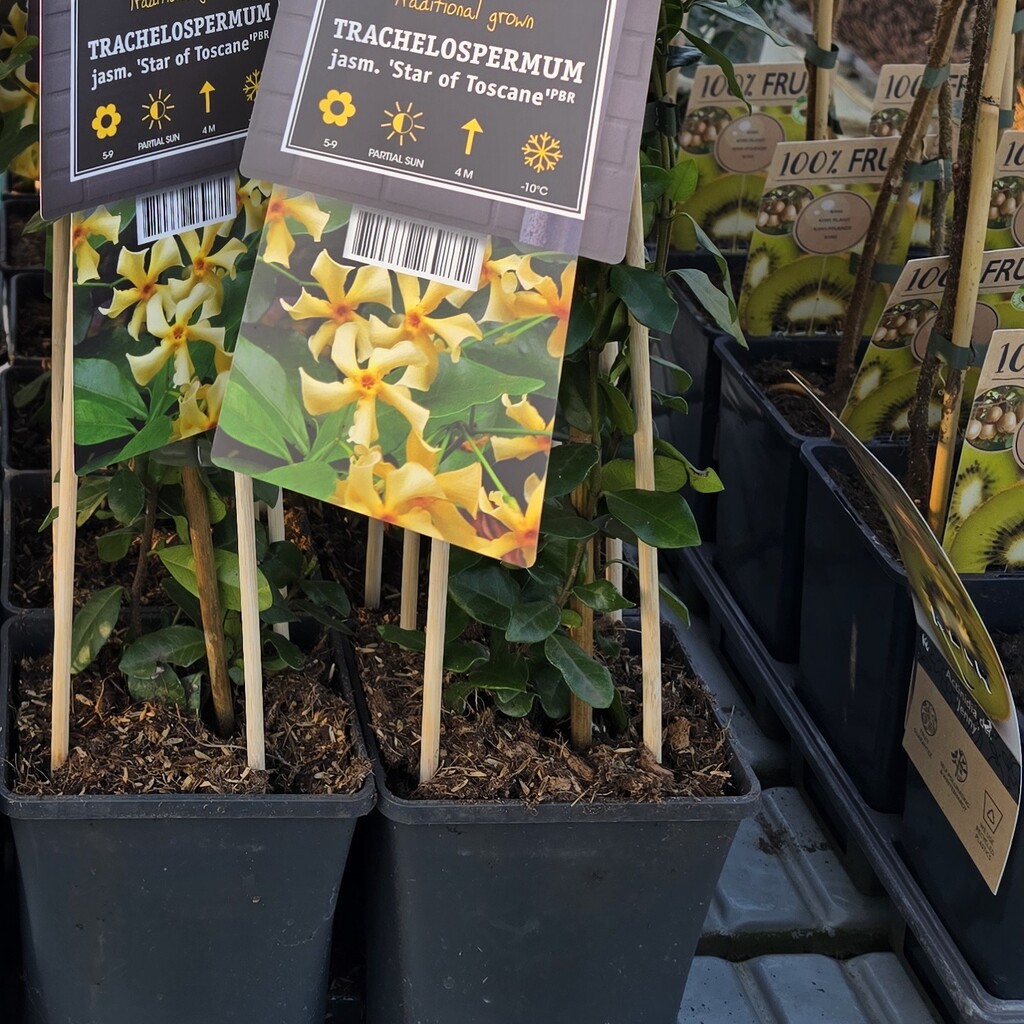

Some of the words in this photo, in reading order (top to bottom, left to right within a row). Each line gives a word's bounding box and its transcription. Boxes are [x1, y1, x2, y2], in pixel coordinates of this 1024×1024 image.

[88, 2, 272, 61] TRACHELOSPERMUM
[486, 9, 534, 32] grown
[333, 18, 585, 85] TRACHELOSPERMUM
[91, 68, 132, 90] jasm.
[137, 56, 170, 75] 'Star
[175, 50, 190, 67] of
[328, 48, 380, 75] jasm.
[389, 59, 433, 86] 'Star
[438, 70, 460, 90] of
[762, 71, 807, 95] FRU
[138, 137, 164, 151] PARTIAL
[165, 133, 180, 145] SUN
[323, 138, 338, 148] 5-9
[102, 149, 114, 160] 5-9
[368, 148, 404, 165] PARTIAL
[405, 155, 424, 169] SUN
[779, 149, 843, 176] 100%
[847, 147, 888, 173] FRU
